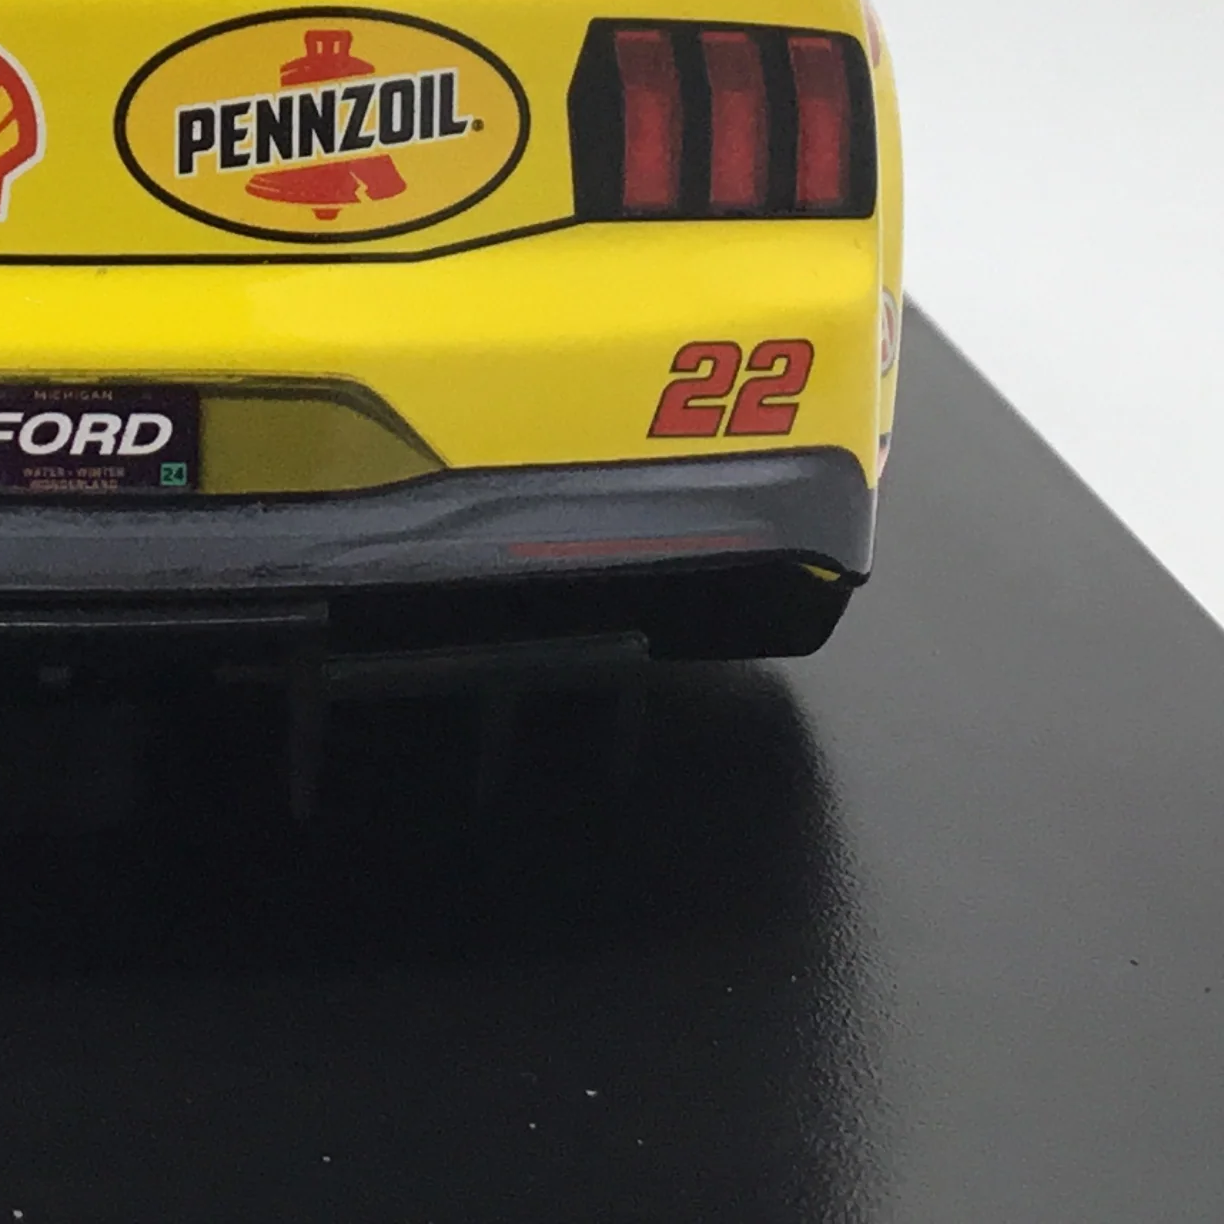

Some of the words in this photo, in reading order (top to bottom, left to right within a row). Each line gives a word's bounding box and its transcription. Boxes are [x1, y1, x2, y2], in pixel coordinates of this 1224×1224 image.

[176, 68, 469, 176] PENNZOIL
[646, 339, 815, 439] 22
[163, 467, 184, 482] 24
